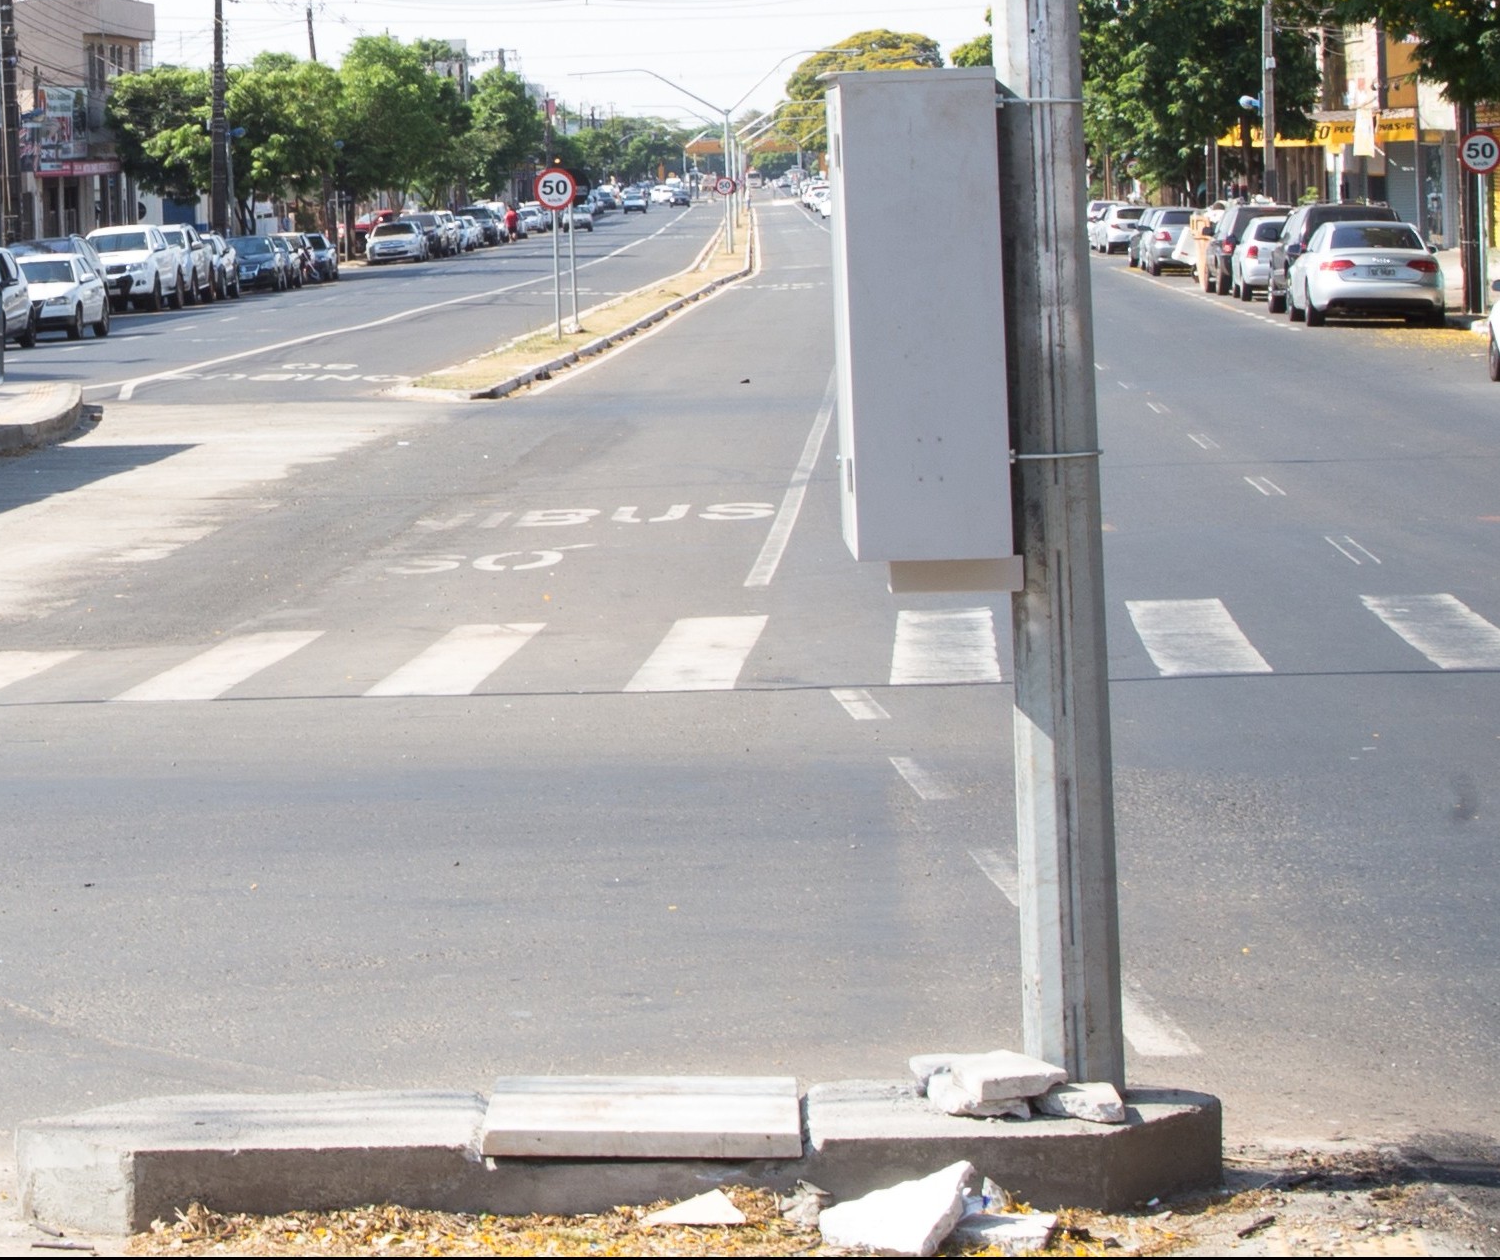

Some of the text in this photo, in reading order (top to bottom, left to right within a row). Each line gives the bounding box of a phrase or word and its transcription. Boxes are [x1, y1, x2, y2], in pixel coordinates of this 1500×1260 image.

[1466, 142, 1495, 159] 50
[542, 180, 567, 195] 50
[720, 181, 730, 189] 50
